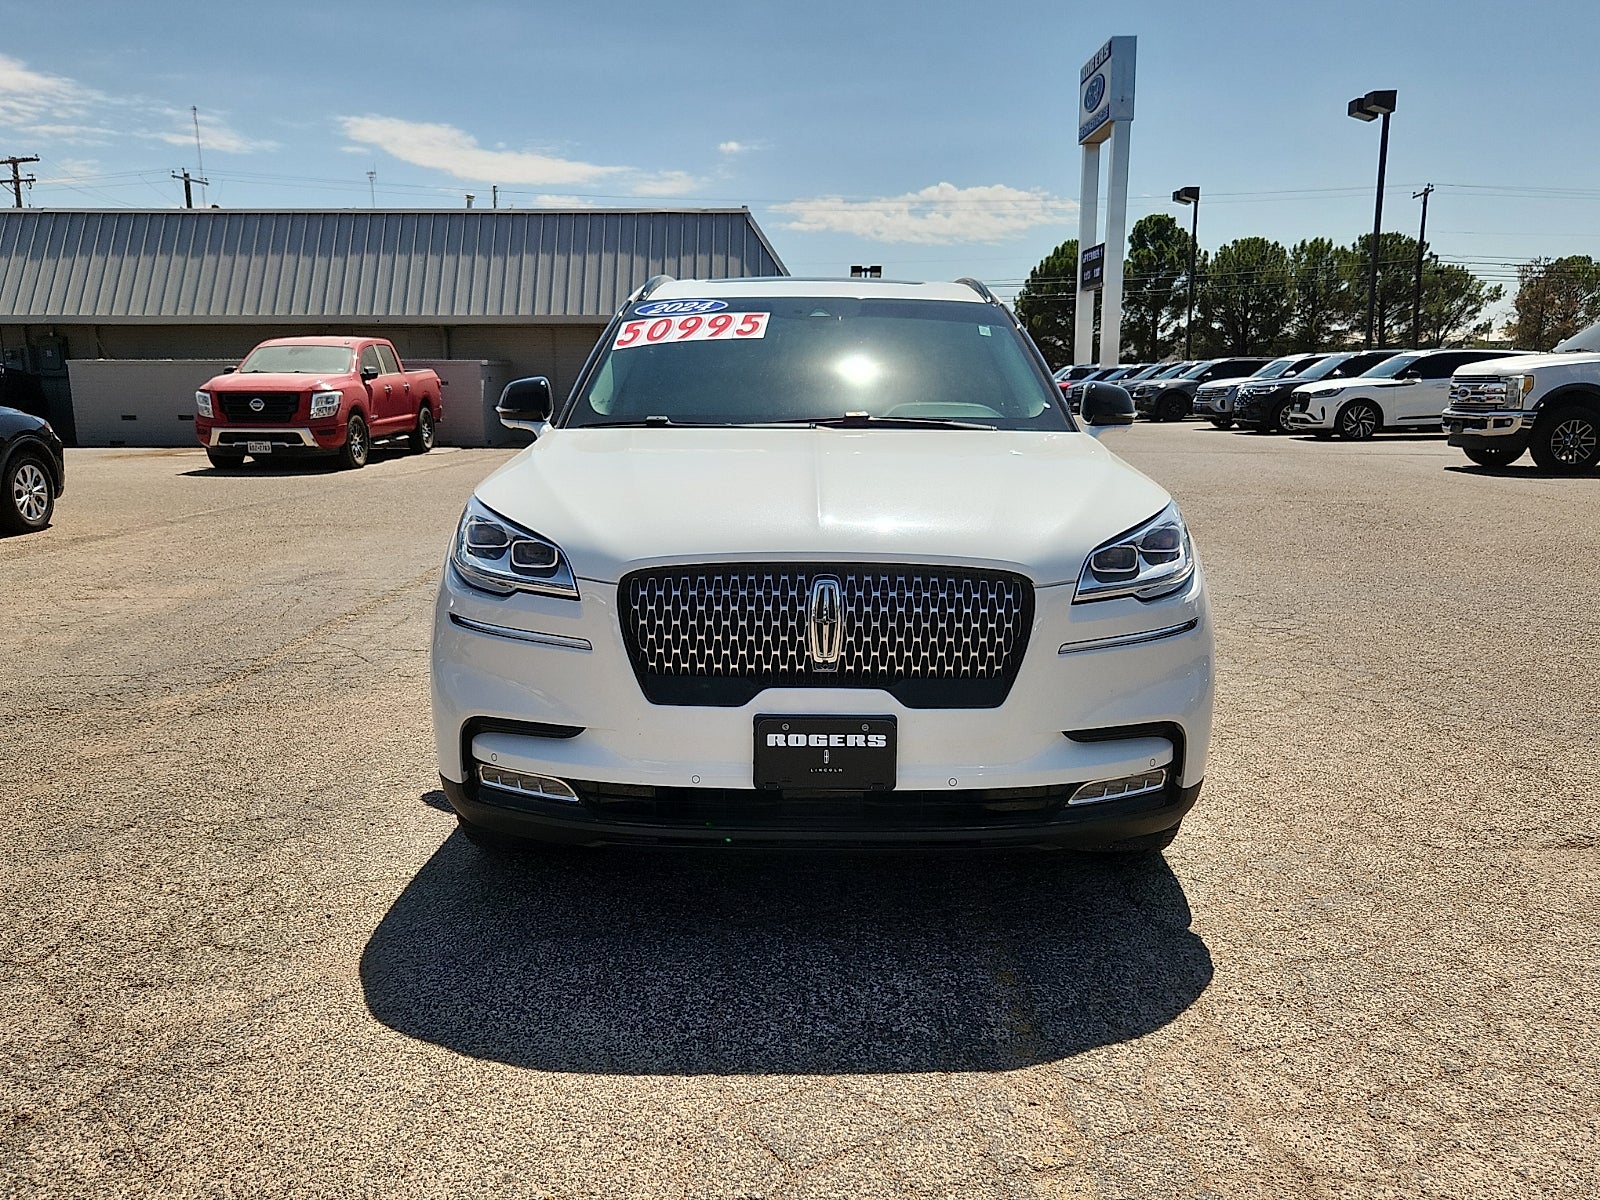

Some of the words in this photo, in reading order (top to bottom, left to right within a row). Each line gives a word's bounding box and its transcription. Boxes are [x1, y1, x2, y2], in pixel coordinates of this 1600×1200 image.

[652, 301, 716, 314] 2024
[616, 314, 766, 347] 50995
[766, 733, 887, 747] ROGERS
